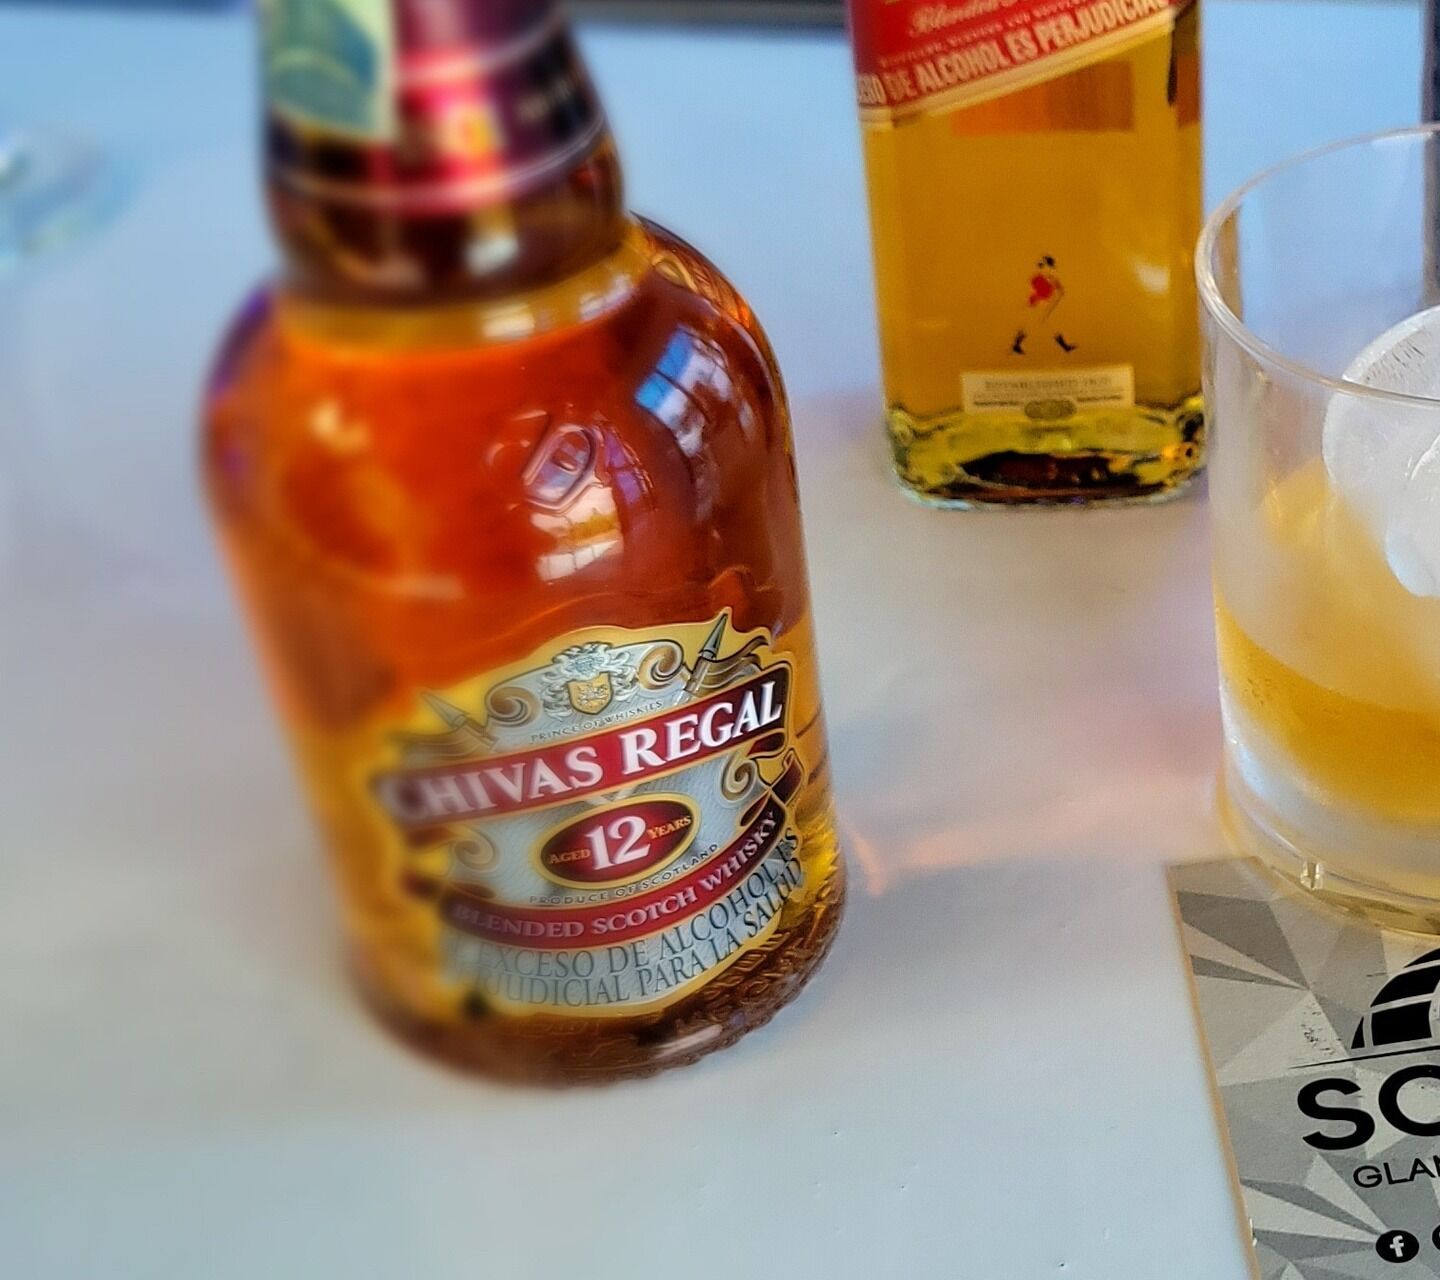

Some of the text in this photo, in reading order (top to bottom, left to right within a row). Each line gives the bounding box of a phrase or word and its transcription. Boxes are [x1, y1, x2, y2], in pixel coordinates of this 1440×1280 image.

[916, 40, 1007, 94] ALCOHOL
[1003, 27, 1039, 65] ES
[376, 679, 783, 821] CHIVAS REGAL
[530, 724, 580, 742] PRINCE
[604, 699, 664, 725] WHISKIES
[452, 810, 777, 938] BLENDED SCOTCH WHISKY
[528, 843, 720, 905] PRODUCE OF SCOTLAND
[549, 815, 692, 871] AGED 12 YEARS
[477, 943, 596, 979] EXCESO
[606, 938, 651, 974] DE
[657, 862, 780, 962] ALCOHOL
[632, 945, 709, 997] PARA
[706, 925, 744, 964] LA
[740, 855, 803, 939] SALUD
